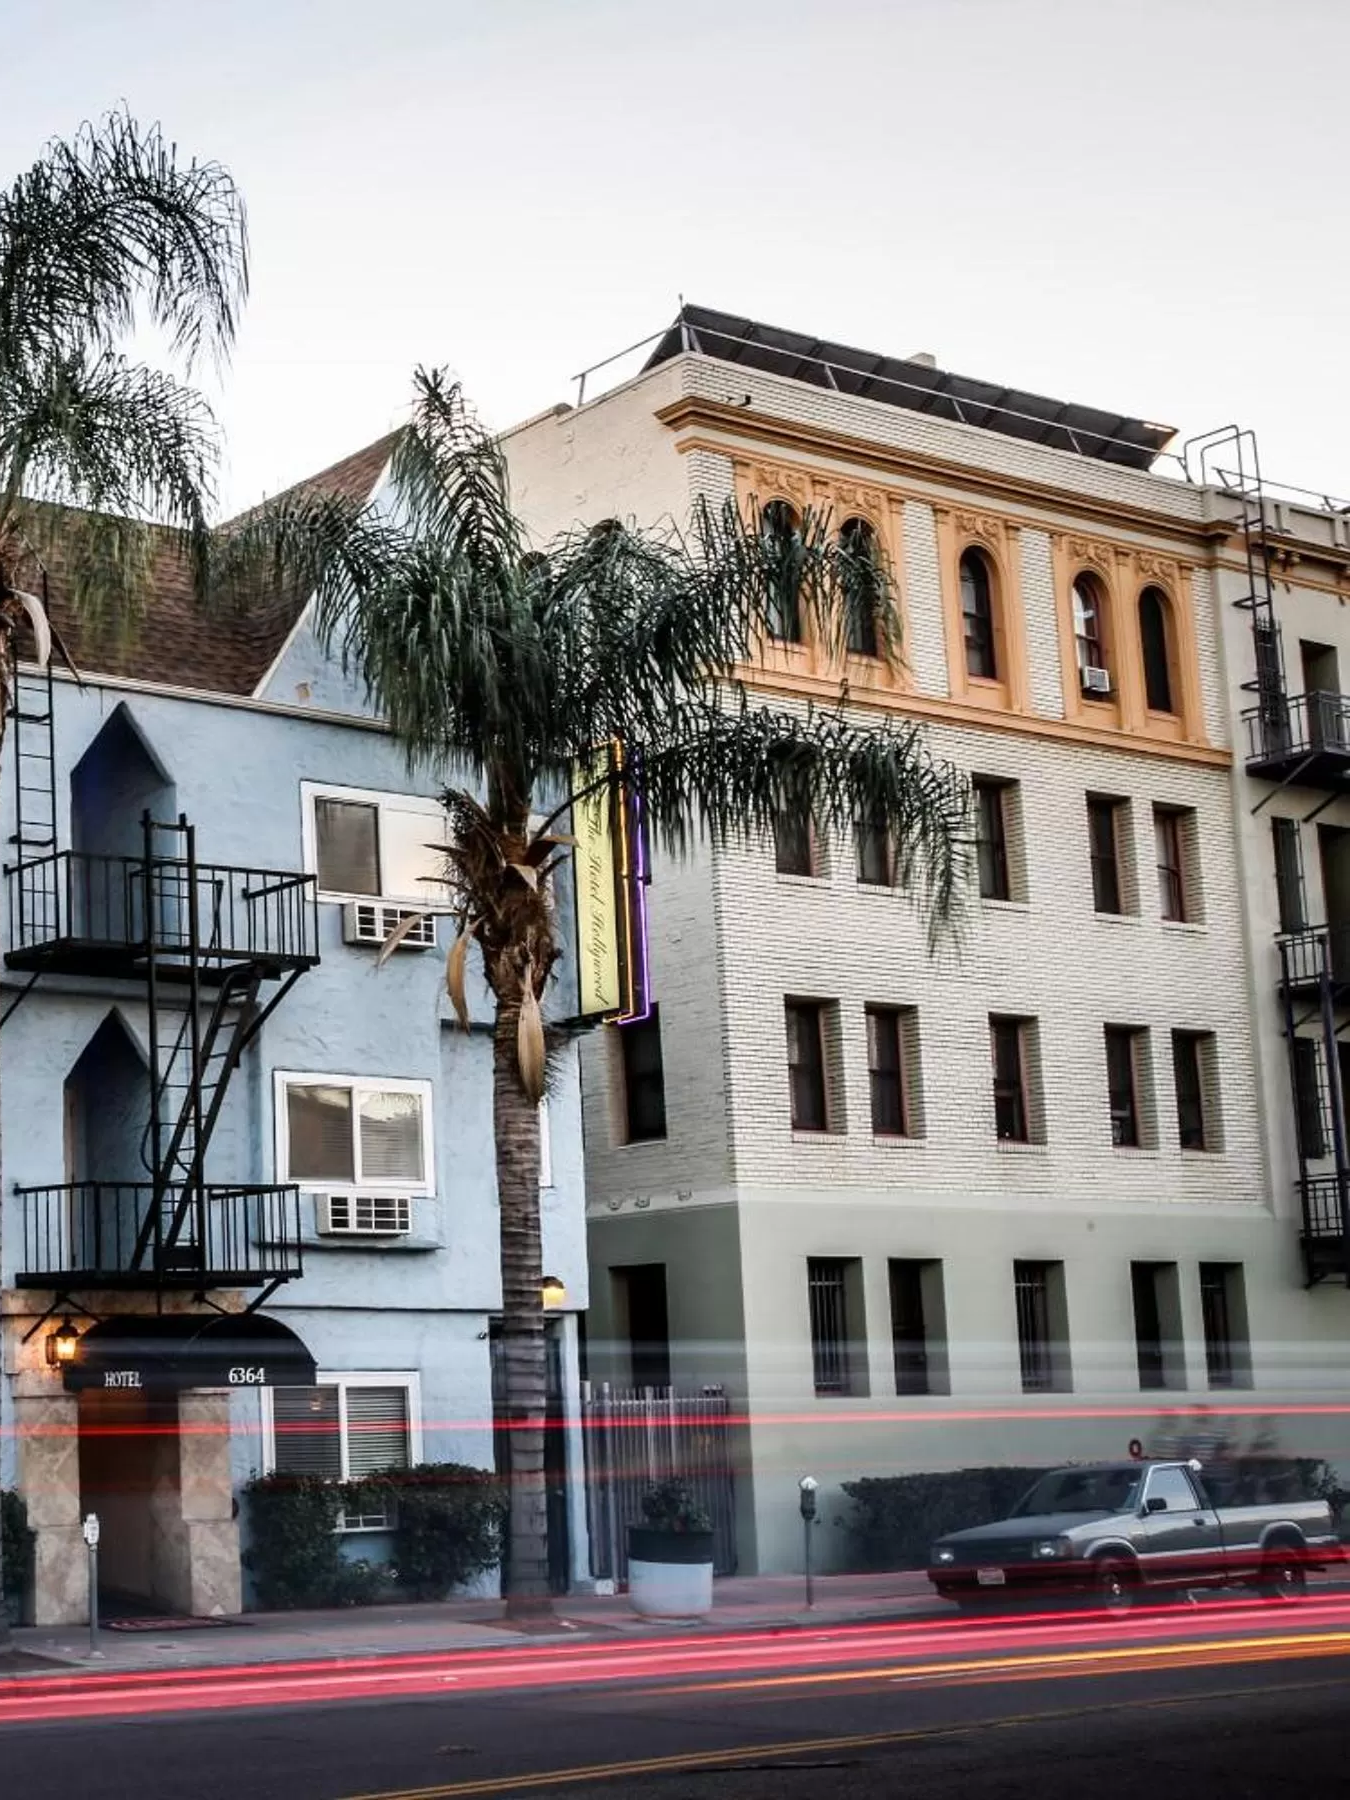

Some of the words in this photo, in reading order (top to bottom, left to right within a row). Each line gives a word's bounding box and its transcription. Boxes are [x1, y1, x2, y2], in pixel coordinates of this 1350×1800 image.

[588, 848, 606, 906] Hotel
[587, 907, 610, 1006] Hollywood
[104, 1371, 143, 1388] HOTEL
[228, 1367, 266, 1384] 6364
